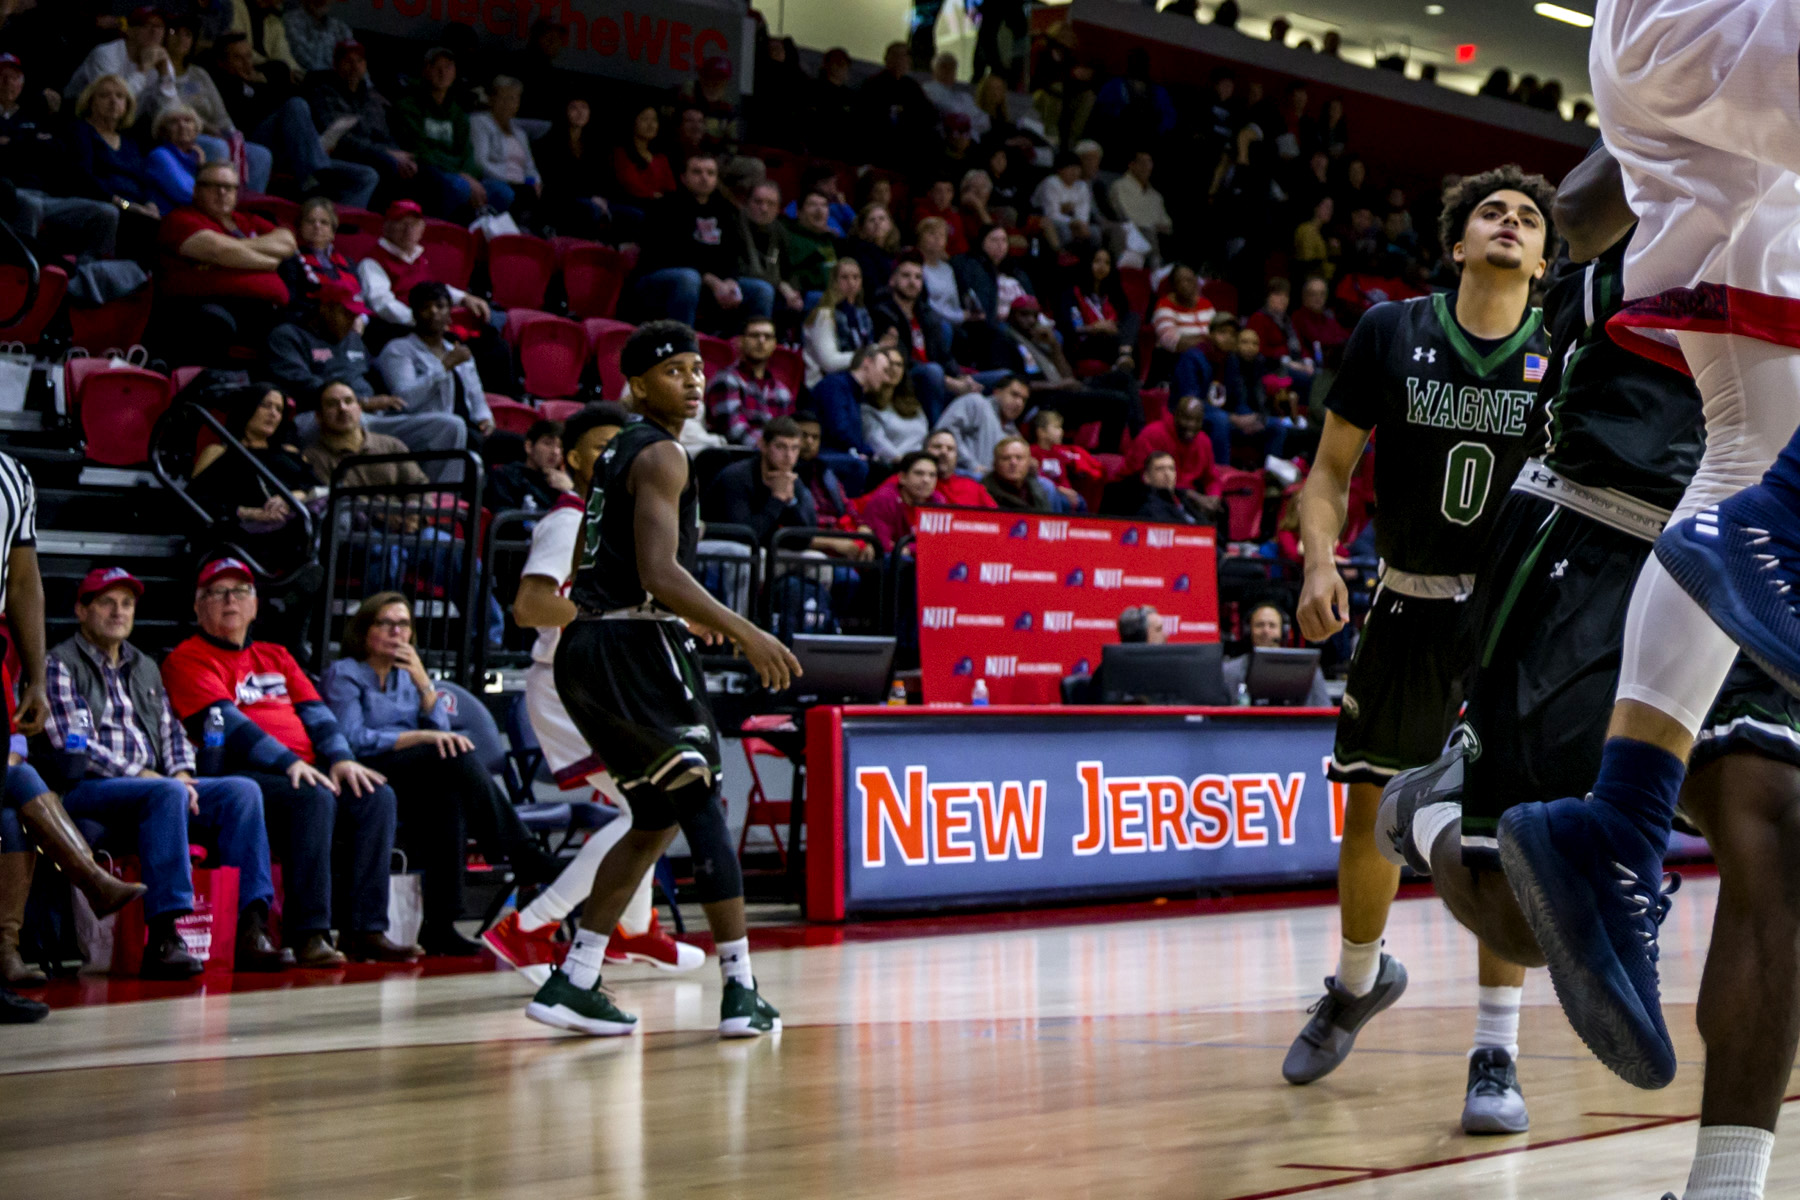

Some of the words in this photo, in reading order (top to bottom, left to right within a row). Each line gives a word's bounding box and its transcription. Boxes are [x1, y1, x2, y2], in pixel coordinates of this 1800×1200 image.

[1406, 377, 1538, 437] WAGNE
[1440, 440, 1496, 527] 0
[985, 655, 1018, 679] NJIT
[855, 764, 1047, 868] NEW
[1073, 760, 1306, 856] JERSEY
